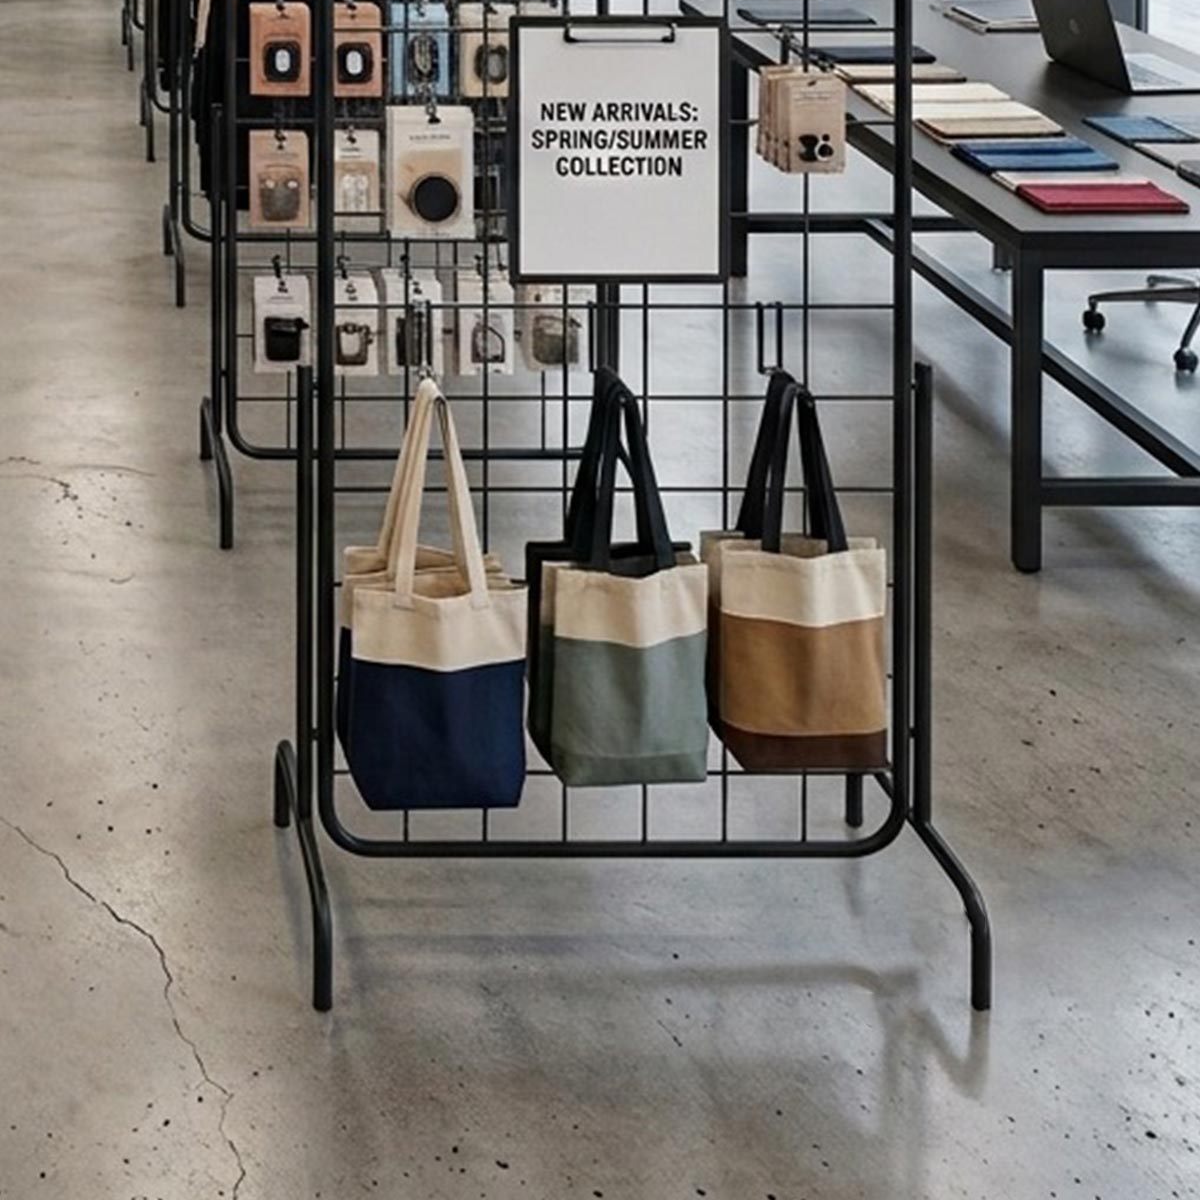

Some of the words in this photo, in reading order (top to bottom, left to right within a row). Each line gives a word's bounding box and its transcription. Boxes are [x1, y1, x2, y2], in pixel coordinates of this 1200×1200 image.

[540, 102, 587, 122] NEW
[591, 101, 699, 123] ARRIVALS:
[531, 129, 708, 150] SPRING/SUMMER
[555, 155, 683, 177] COLLECTION
